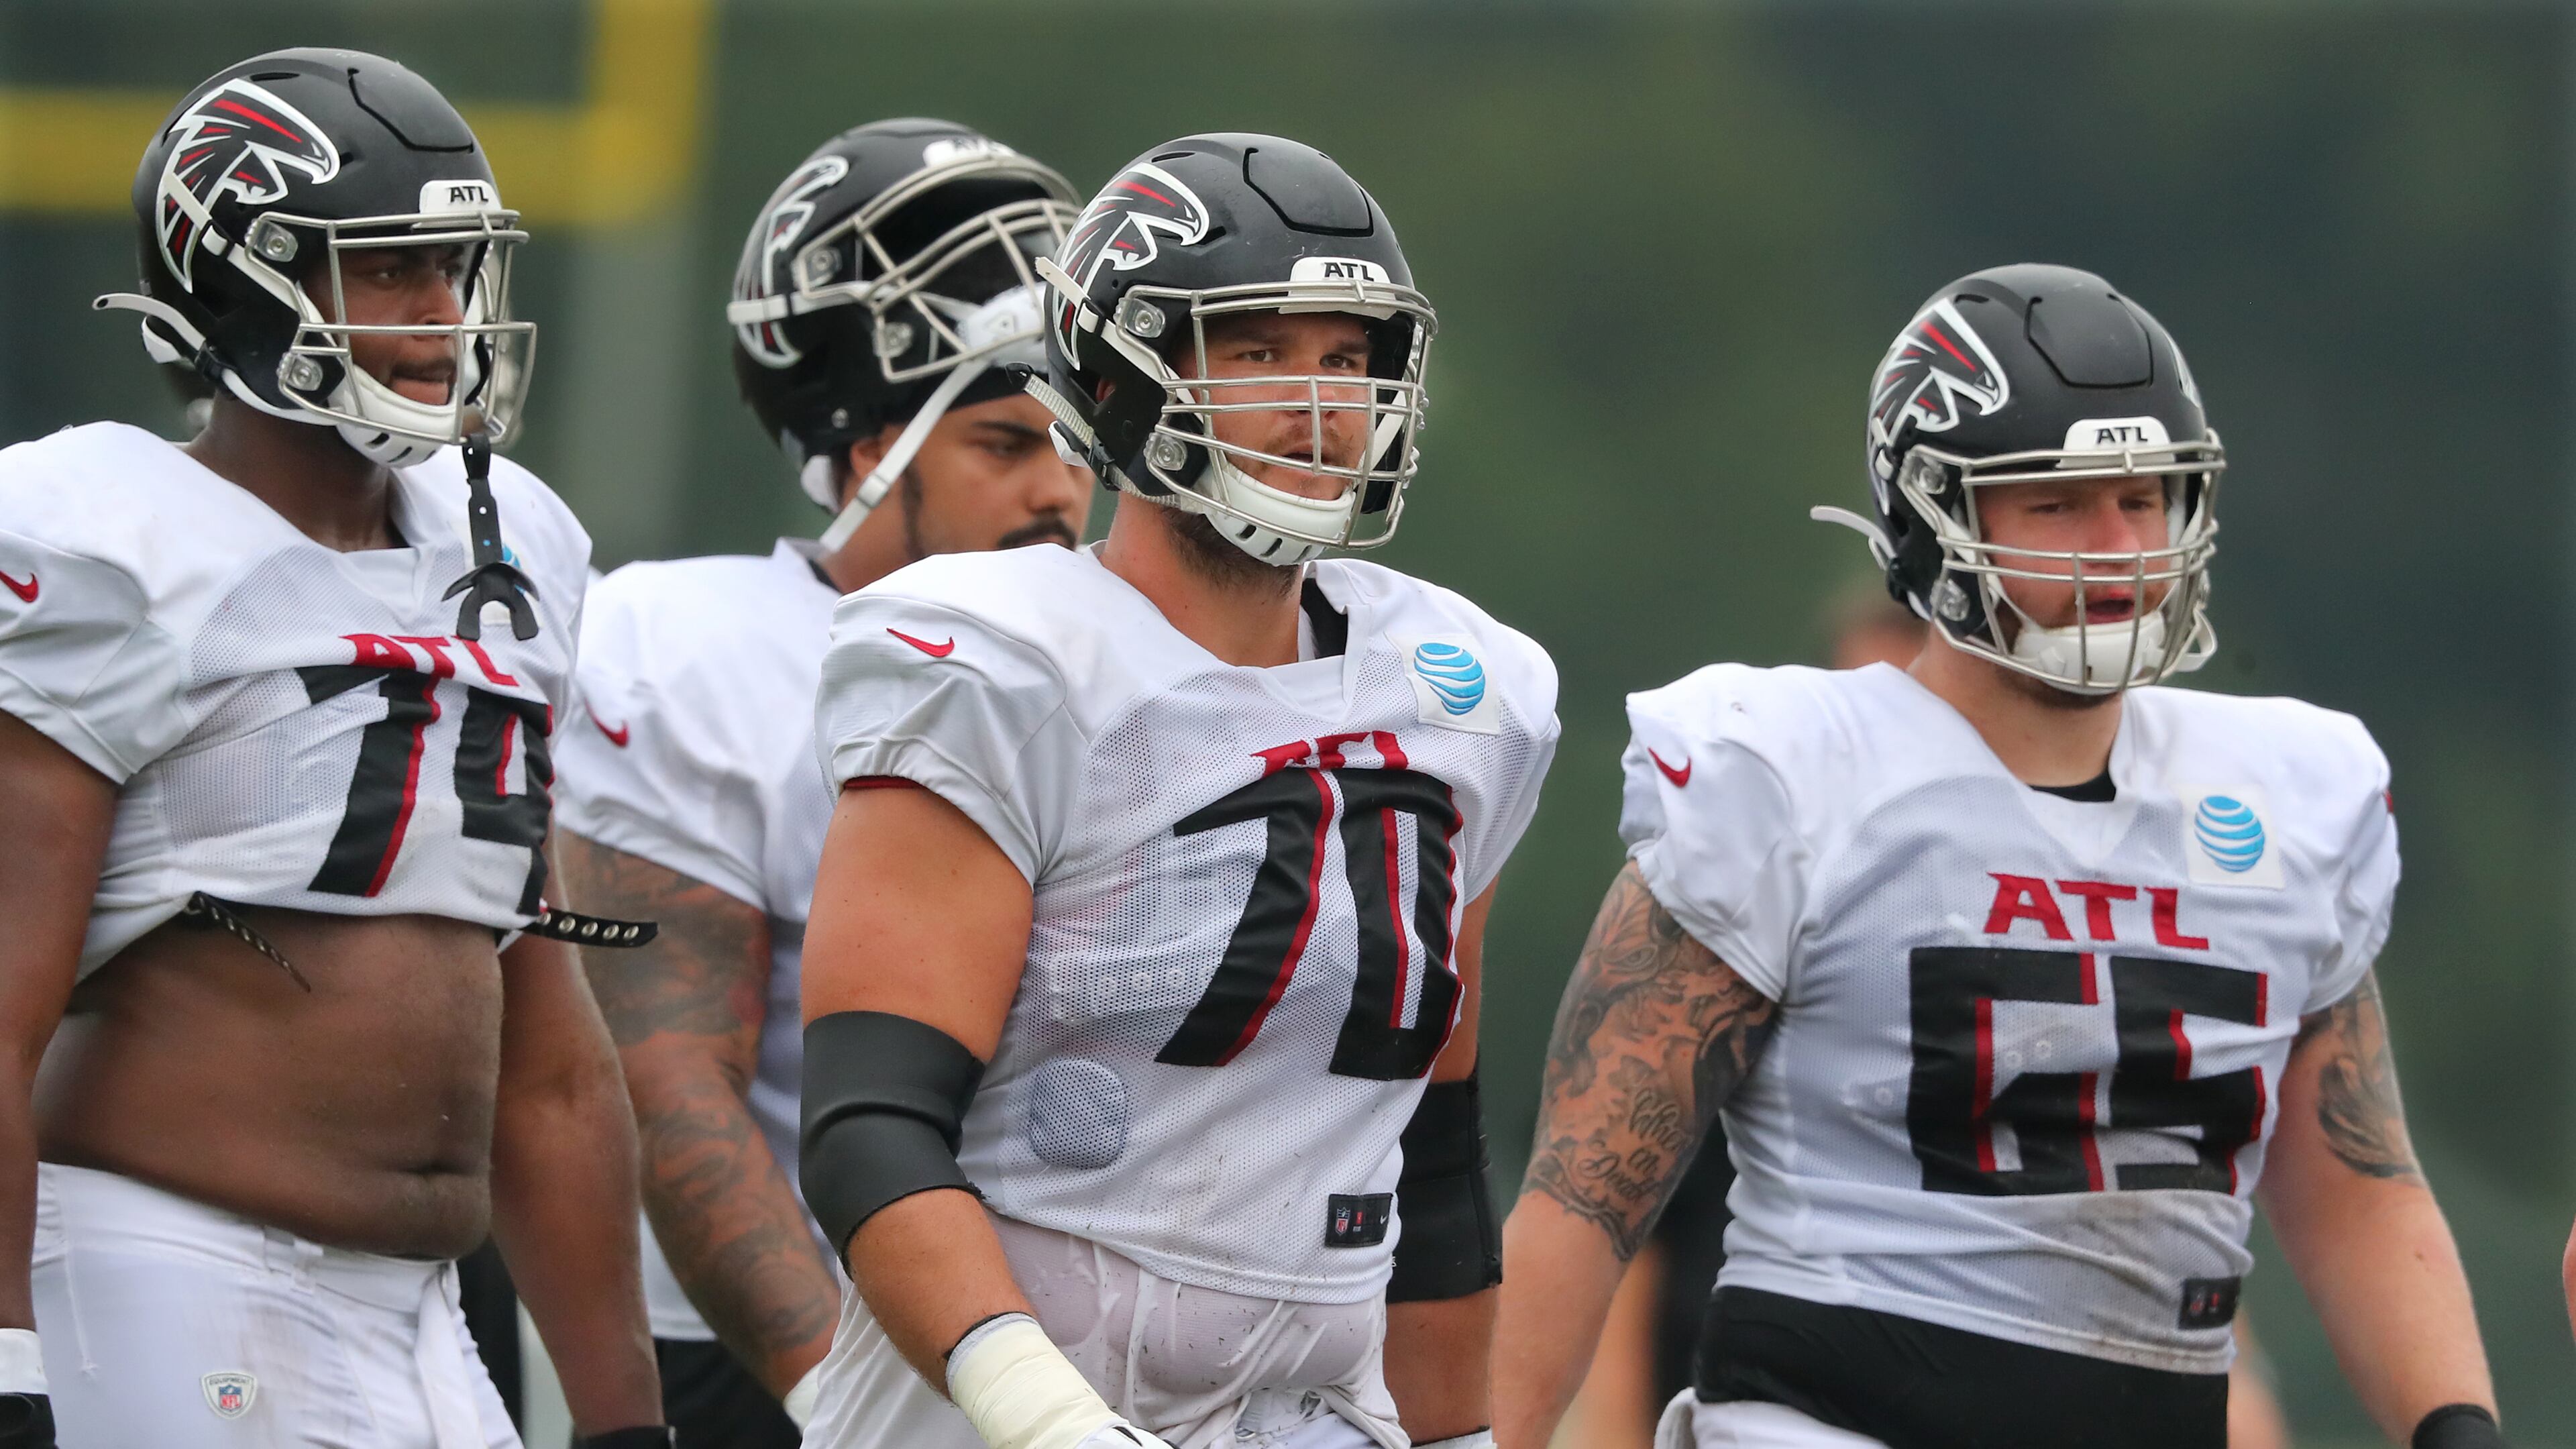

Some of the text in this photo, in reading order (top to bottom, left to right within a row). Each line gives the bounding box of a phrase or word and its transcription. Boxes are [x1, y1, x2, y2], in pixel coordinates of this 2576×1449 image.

[449, 185, 489, 203] ATL
[1324, 262, 1375, 282] ATL
[2096, 426, 2149, 445] ATL
[1984, 872, 2209, 951] ATL
[1154, 767, 1464, 1081] 70
[1906, 946, 2267, 1197] 65
[221, 1394, 241, 1408] NFL
